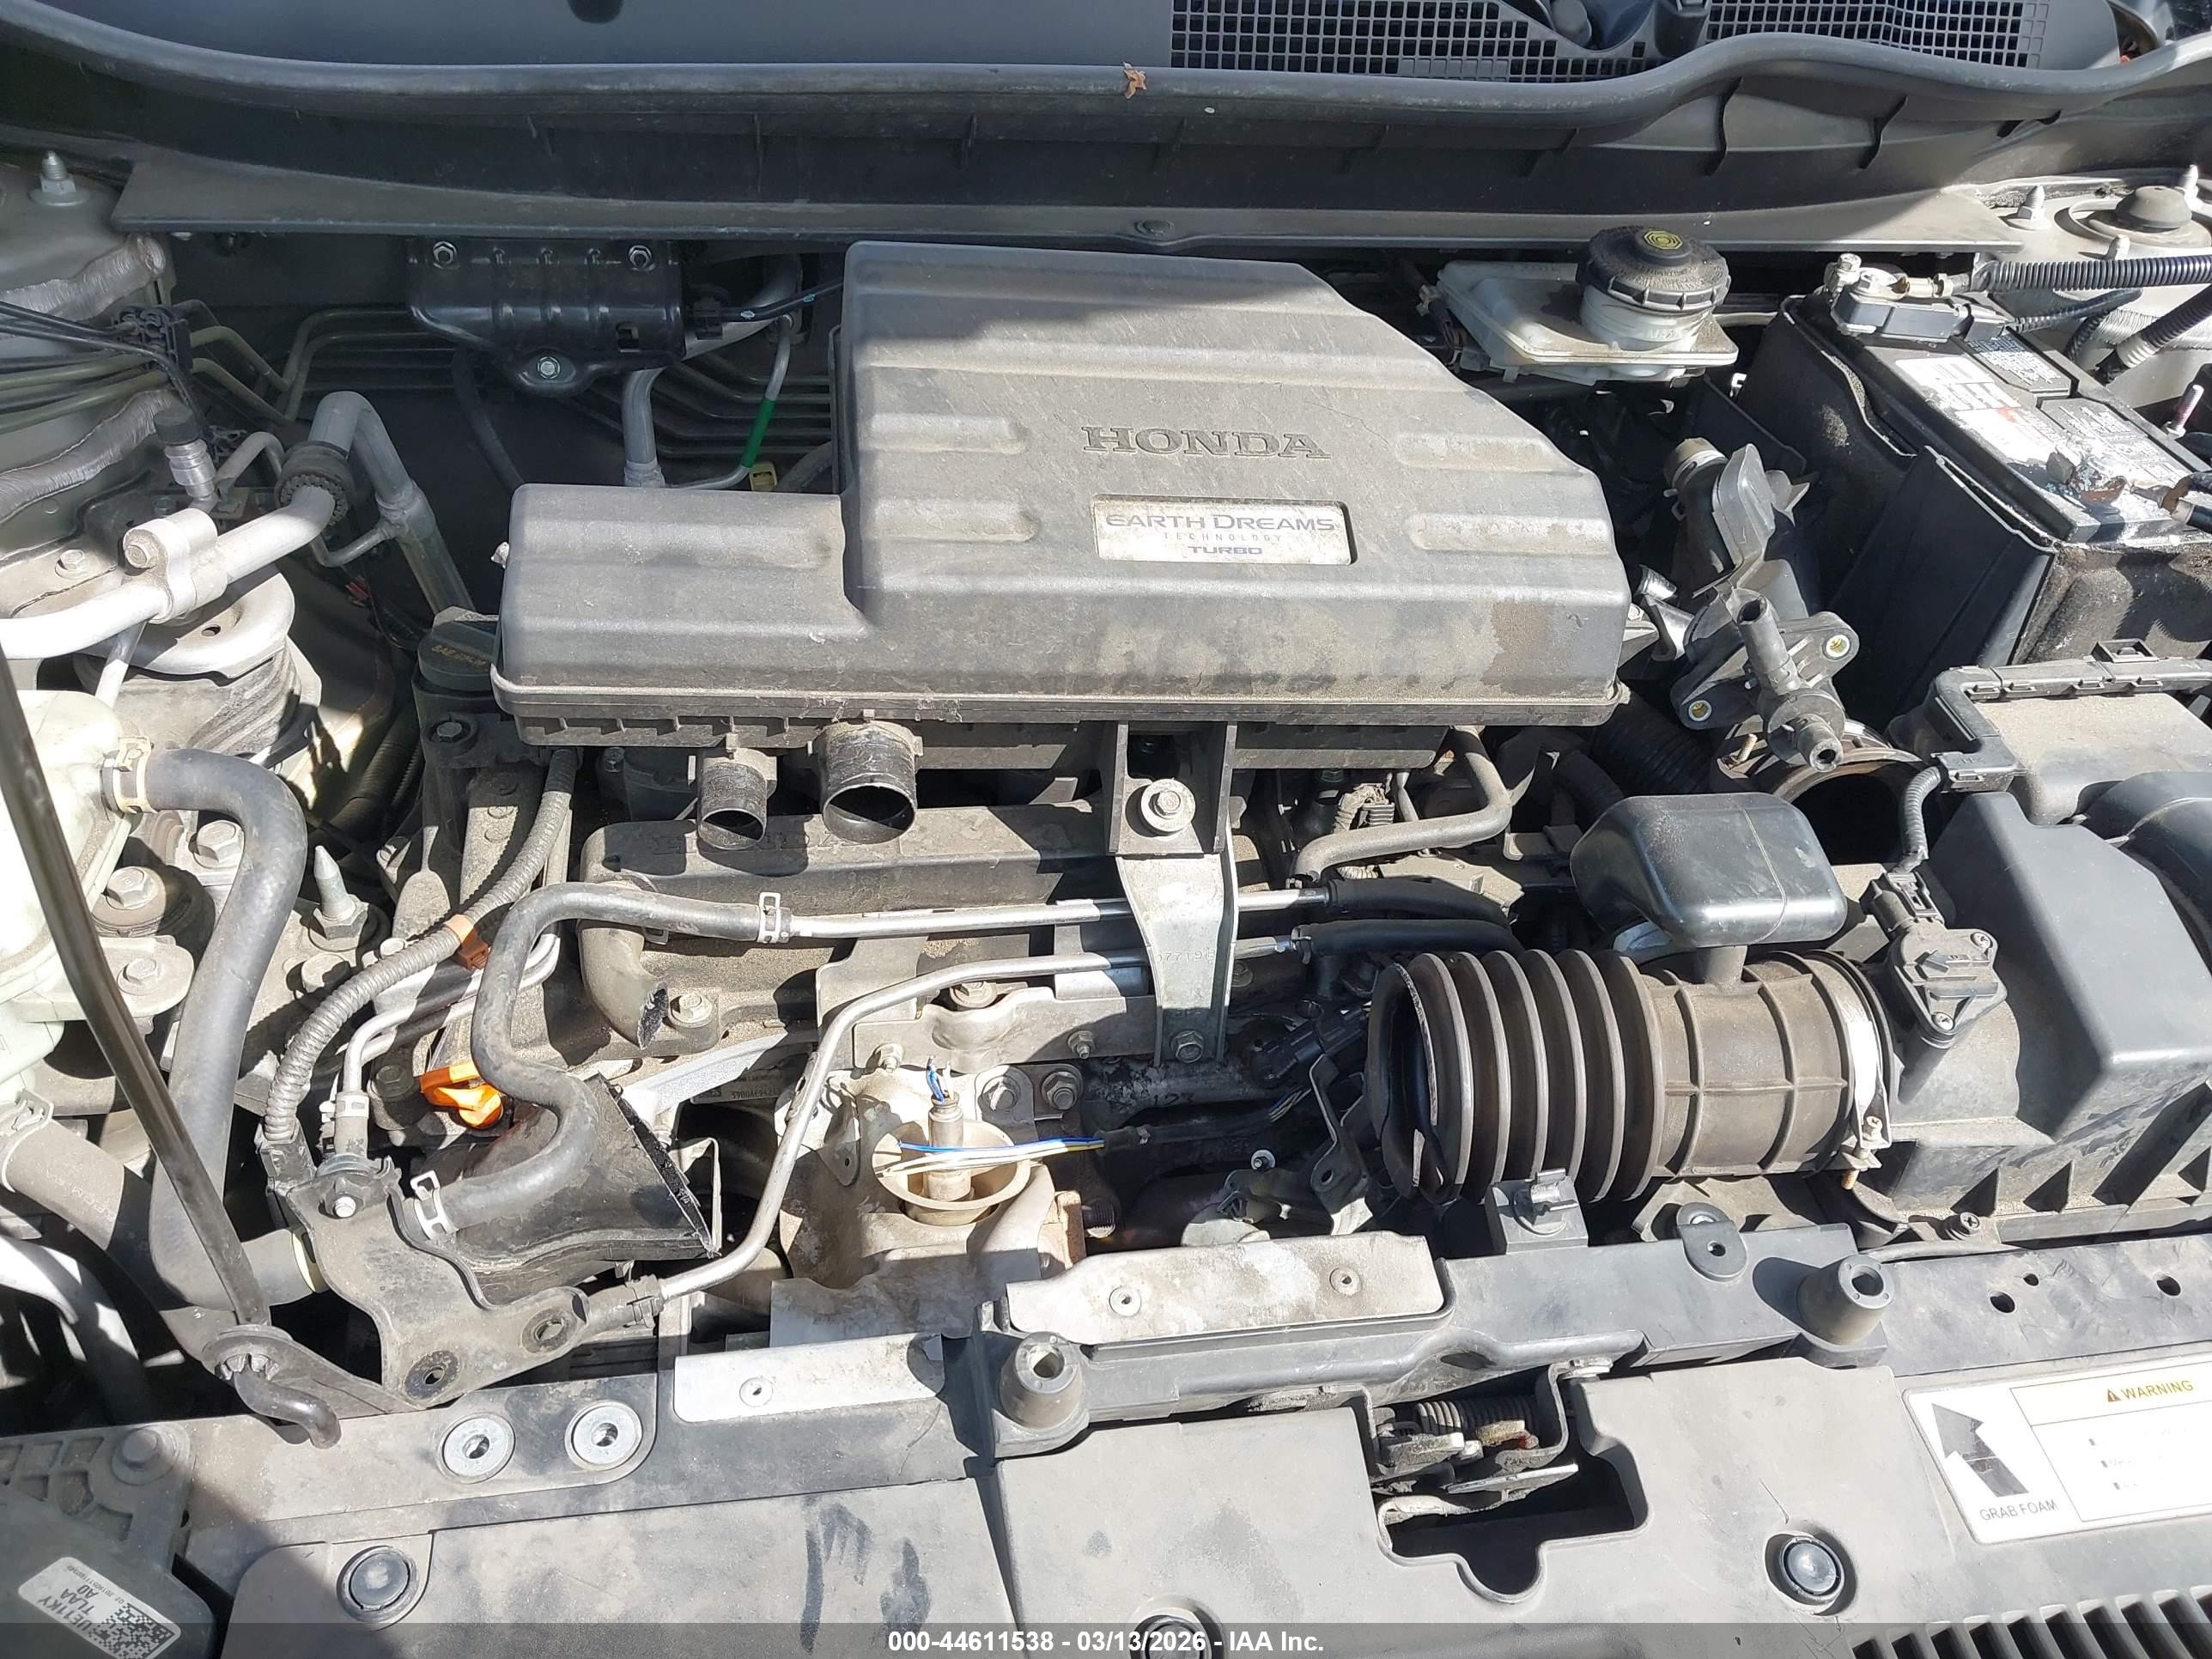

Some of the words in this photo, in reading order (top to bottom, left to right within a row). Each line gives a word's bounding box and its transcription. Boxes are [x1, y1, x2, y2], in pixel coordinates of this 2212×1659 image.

[1081, 427, 1332, 459] HONDA
[1105, 514, 1206, 529] EARTH
[1212, 514, 1335, 532] DREAMS
[1163, 532, 1283, 543] TECHNOLOGY
[1188, 545, 1263, 555] TURBO
[2120, 1380, 2194, 1400] WARNING
[1979, 1504, 2019, 1522] GRAB
[2019, 1498, 2059, 1516] FOAM
[60, 1589, 94, 1616] TLAA
